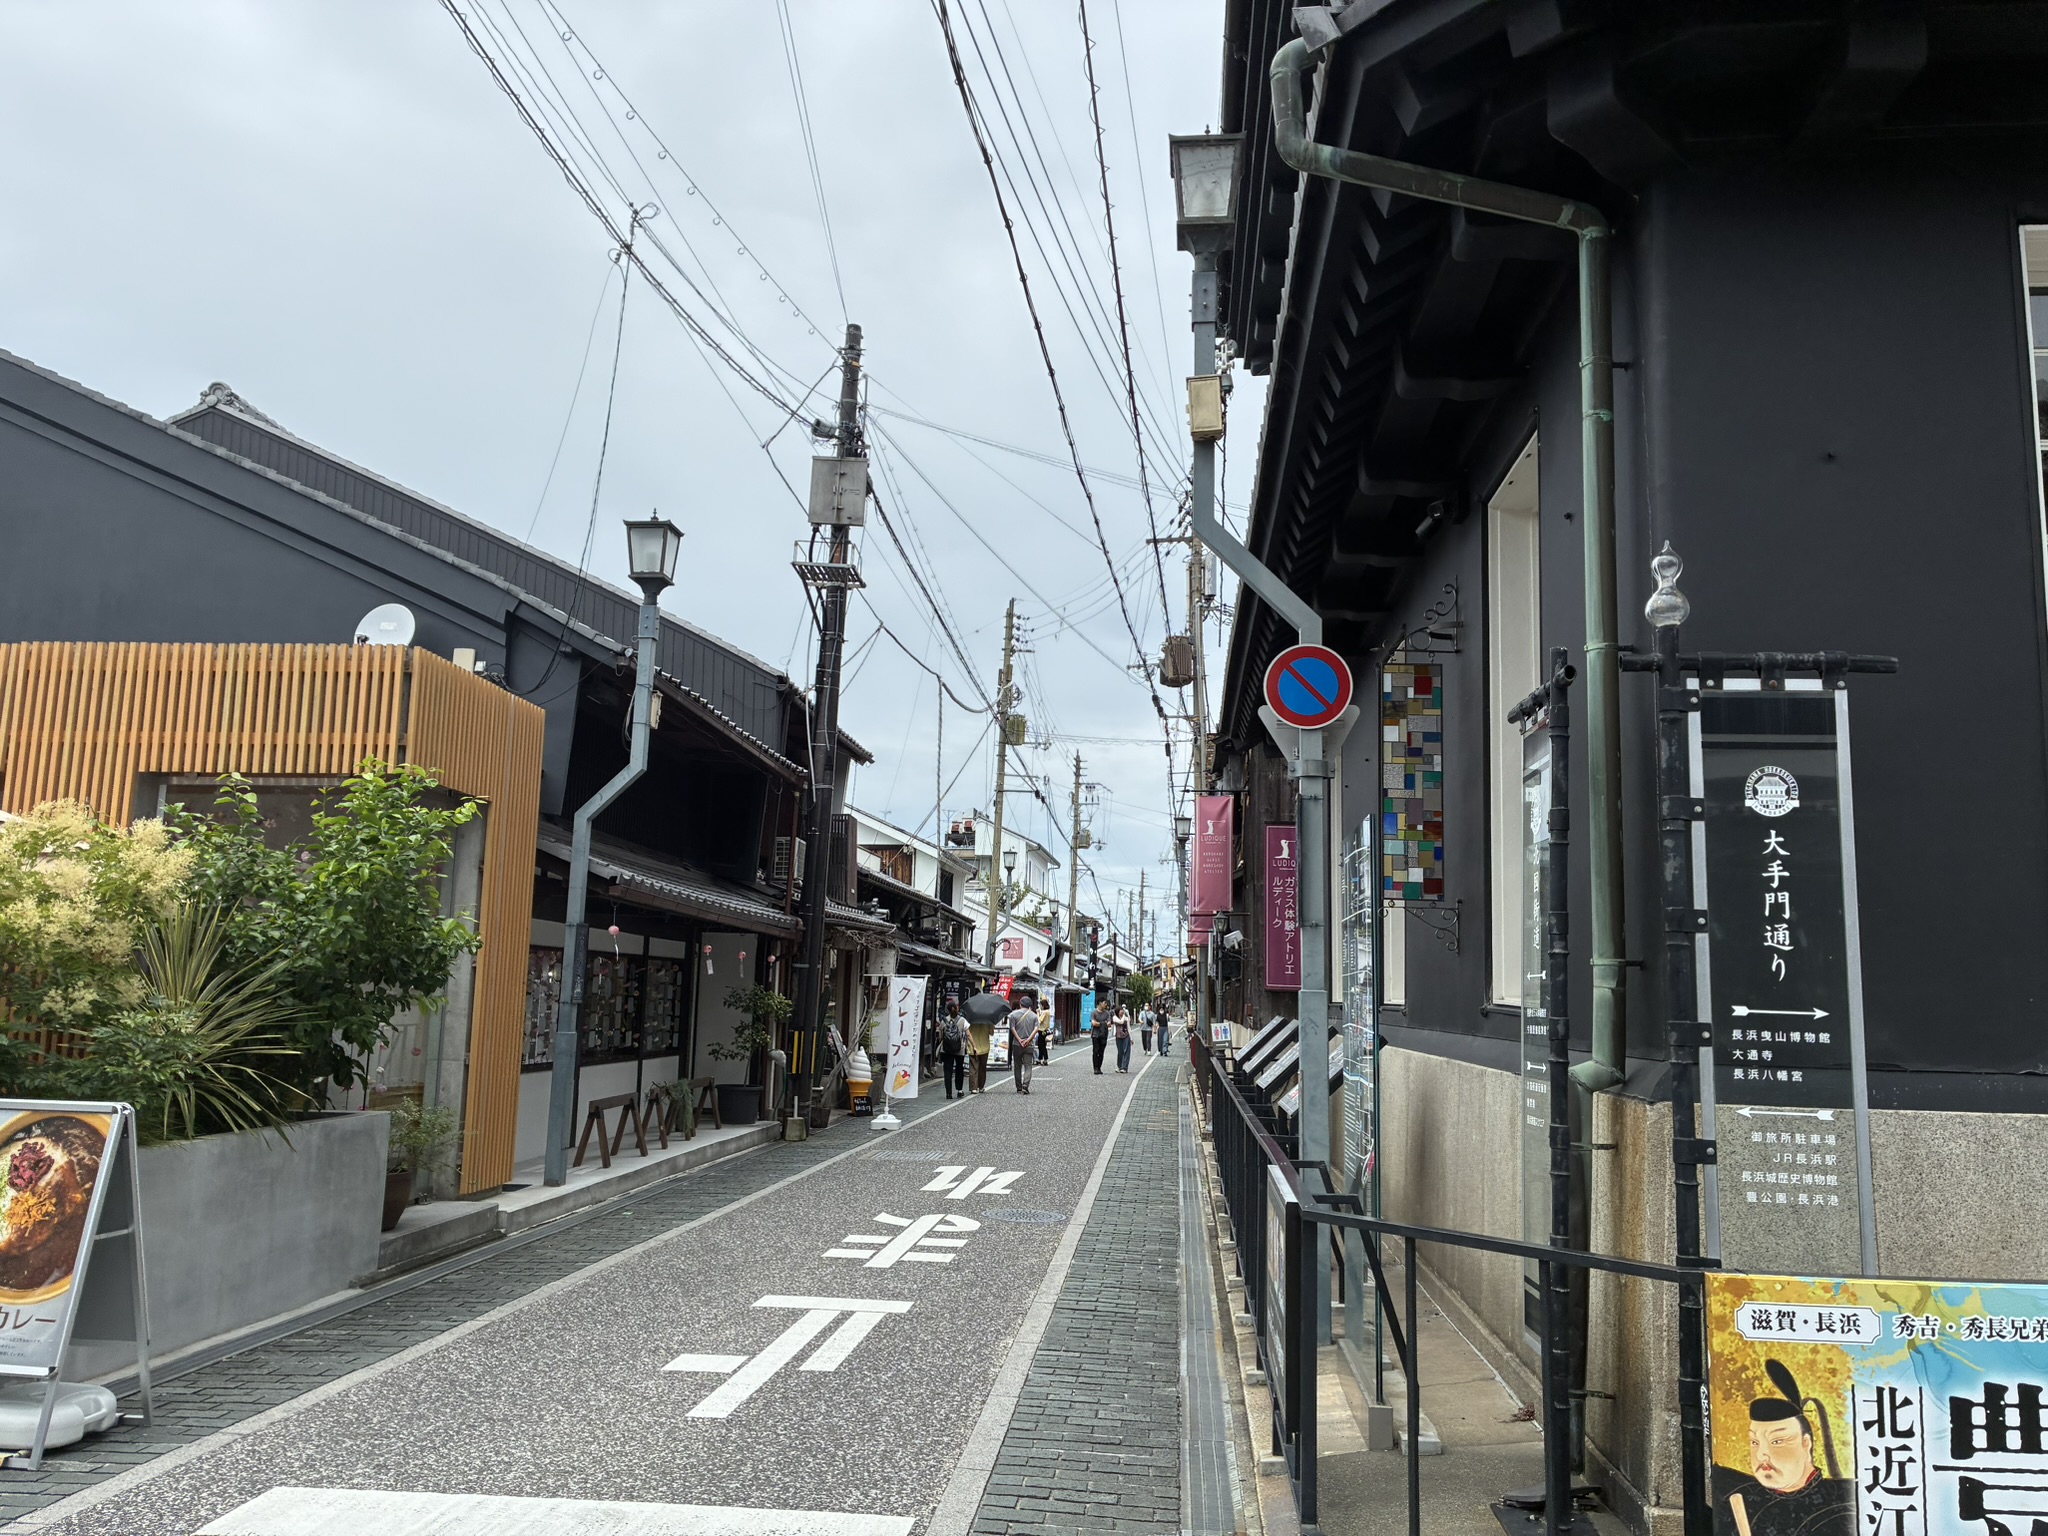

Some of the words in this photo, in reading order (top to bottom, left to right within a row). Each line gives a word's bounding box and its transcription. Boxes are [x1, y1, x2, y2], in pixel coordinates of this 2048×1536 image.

[1272, 859, 1296, 867] LUDIQ
[1272, 876, 1283, 928] ルディーク
[1762, 829, 1794, 982] 大手門通り
[1284, 877, 1296, 974] ガラス体験アトリエ
[891, 986, 911, 1057] クレープ
[1732, 1029, 1831, 1044] 長浜曳山博物館
[1732, 1049, 1773, 1061] 大通寺
[1733, 1068, 1803, 1082] 長浜八幡宮
[1751, 1131, 1836, 1146] 御旅所駐車場
[1773, 1153, 1837, 1166] JR長浜駅
[1741, 1171, 1838, 1186] 長浜城歴史博物館
[1746, 1191, 1839, 1206] 豊公園・長浜港
[1751, 1309, 1862, 1335] 滋賀・長浜
